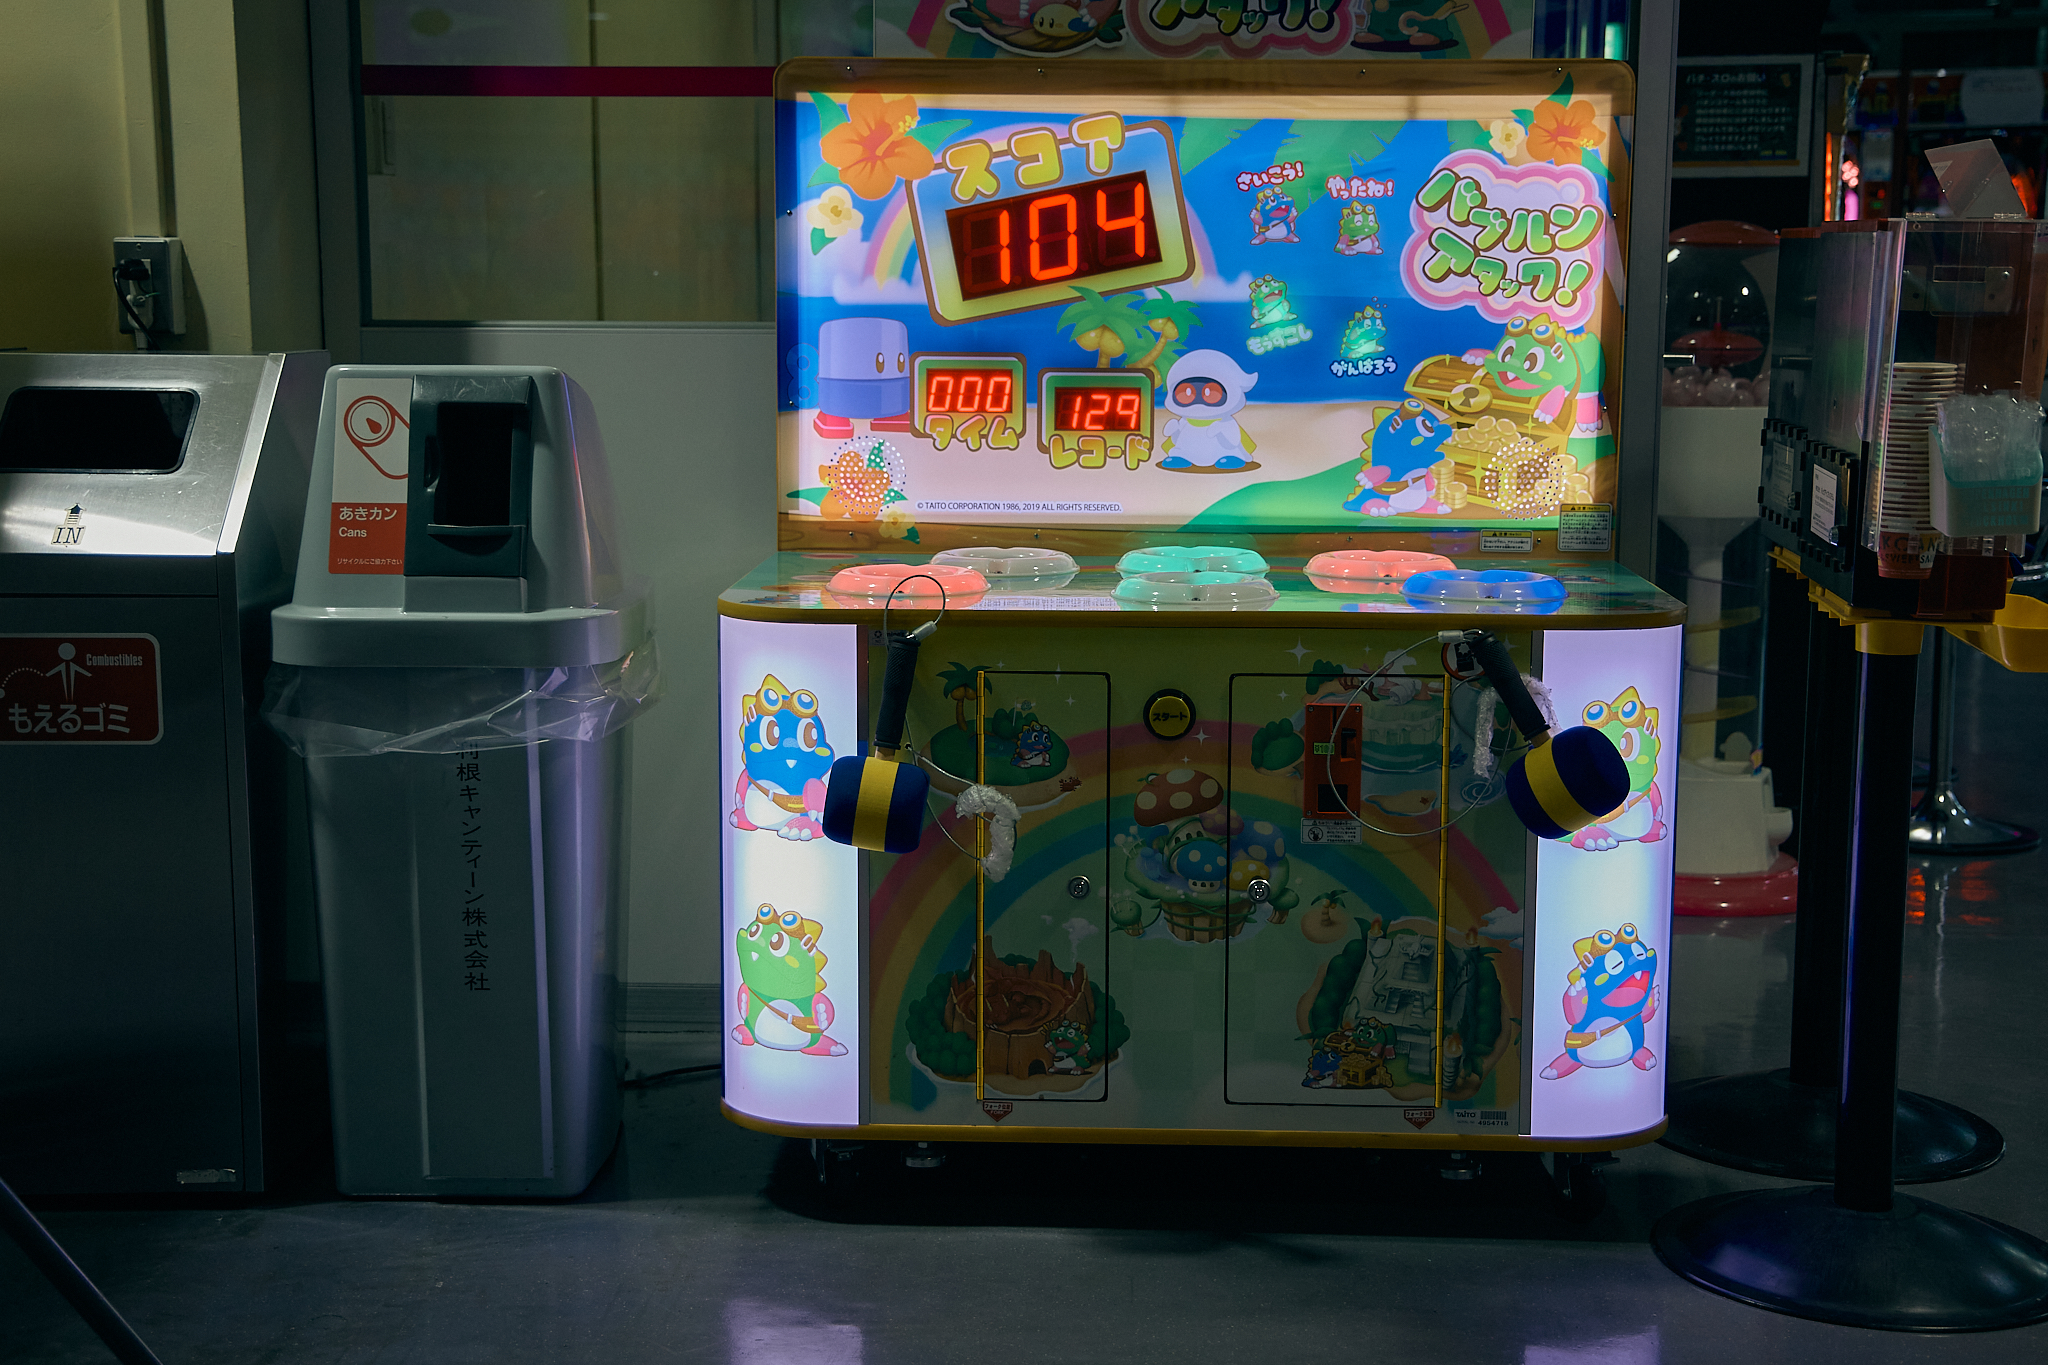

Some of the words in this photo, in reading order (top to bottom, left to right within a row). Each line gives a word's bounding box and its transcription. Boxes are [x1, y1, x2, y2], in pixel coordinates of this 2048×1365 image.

[942, 110, 1125, 204] スコア
[1236, 160, 1304, 191] さいこう!
[1325, 175, 1395, 200] やったね!
[1415, 167, 1604, 255] バブルン
[999, 182, 1145, 281] 104
[1422, 227, 1594, 308] アタック!
[1329, 356, 1398, 378] がんばろう
[928, 376, 1012, 412] 000
[1071, 394, 1141, 431] 129
[924, 414, 1020, 451] タイム
[1048, 433, 1152, 471] レコード
[338, 506, 398, 521] あきカン
[925, 502, 947, 510] TAITO
[947, 502, 1000, 510] CORPORATION
[1002, 503, 1021, 511] 1986,
[1022, 503, 1041, 511] 2019
[1041, 503, 1055, 511] ALL
[1056, 503, 1083, 511] RIGHTS
[1083, 503, 1122, 512] RESERVED.
[52, 526, 85, 544] IN
[338, 526, 368, 538] Cans
[85, 653, 143, 667] Combustibles
[8, 702, 131, 734] もえるゴミ
[1152, 711, 1188, 722] スタート
